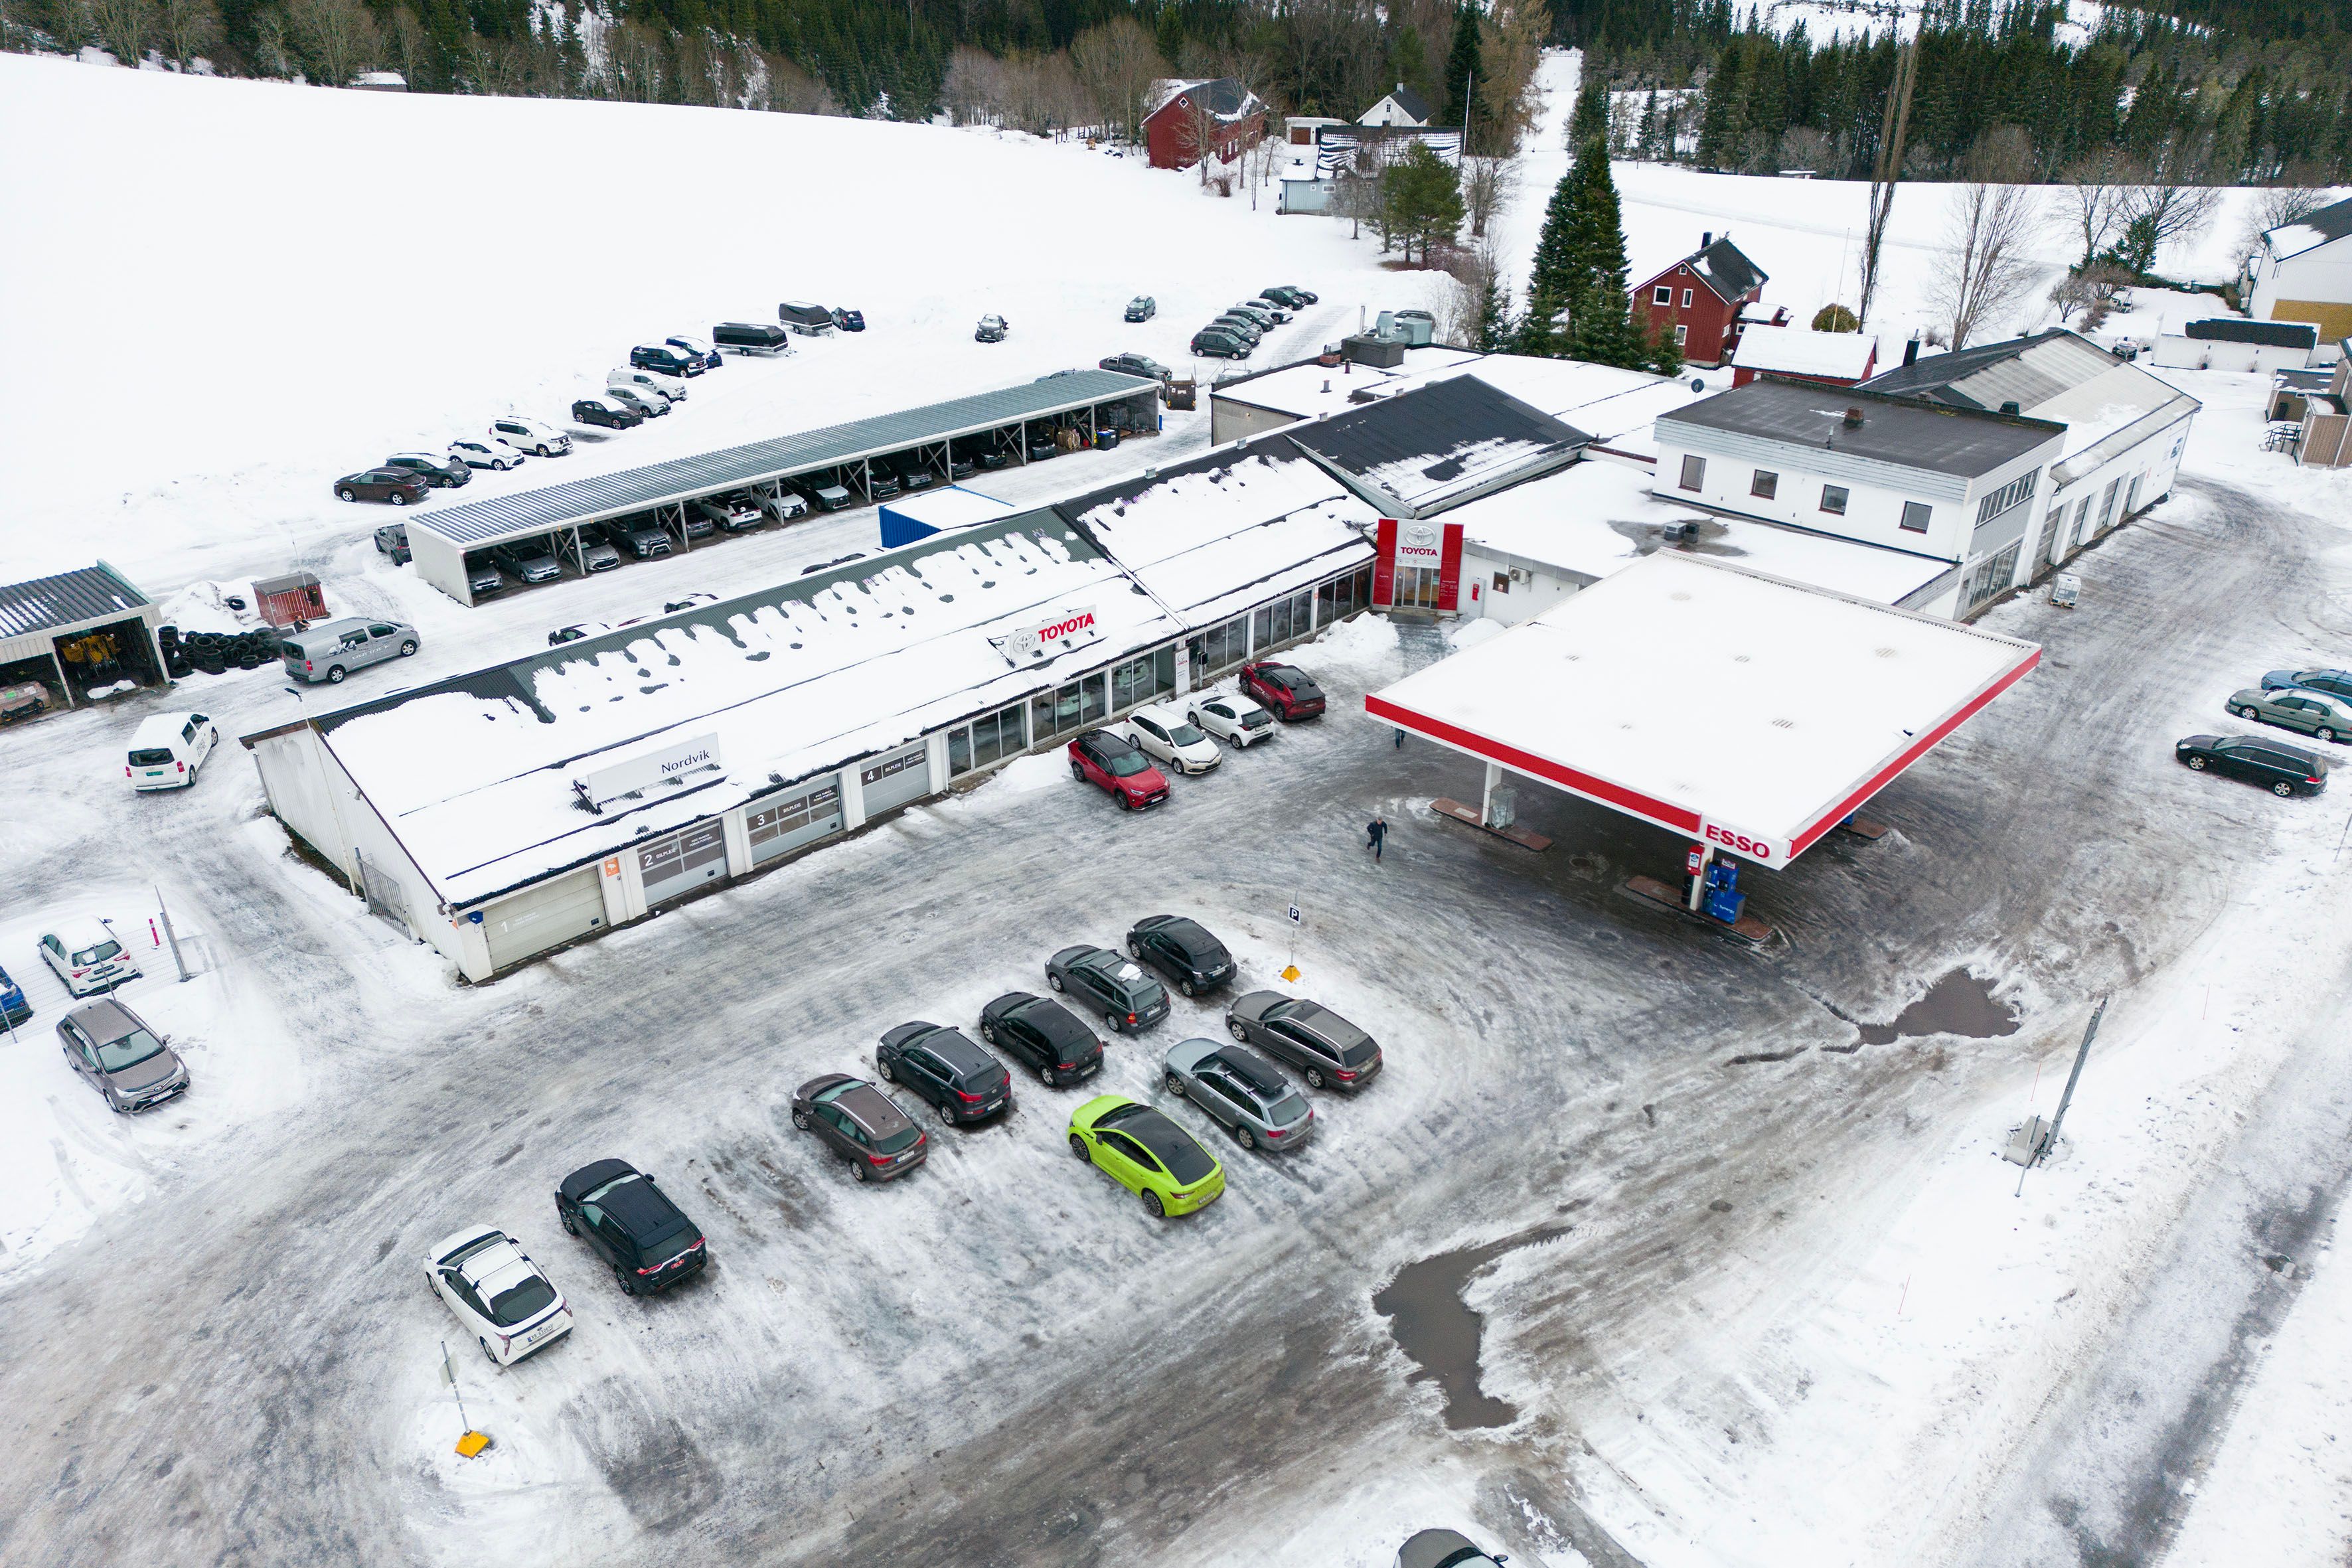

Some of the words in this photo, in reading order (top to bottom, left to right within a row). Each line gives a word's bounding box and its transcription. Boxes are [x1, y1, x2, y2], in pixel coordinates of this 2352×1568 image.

[1400, 546, 1438, 556] TOYOTA
[1038, 612, 1095, 643] TOYOTA
[661, 749, 710, 773] Nordvik
[867, 770, 874, 781] 4
[757, 814, 765, 826] 3
[783, 802, 801, 813] BILPLEIE
[1705, 823, 1770, 858] ESSO
[644, 854, 653, 866] 2
[1291, 909, 1298, 918] P
[1719, 904, 1735, 914] Synergy
[501, 921, 508, 932] 1
